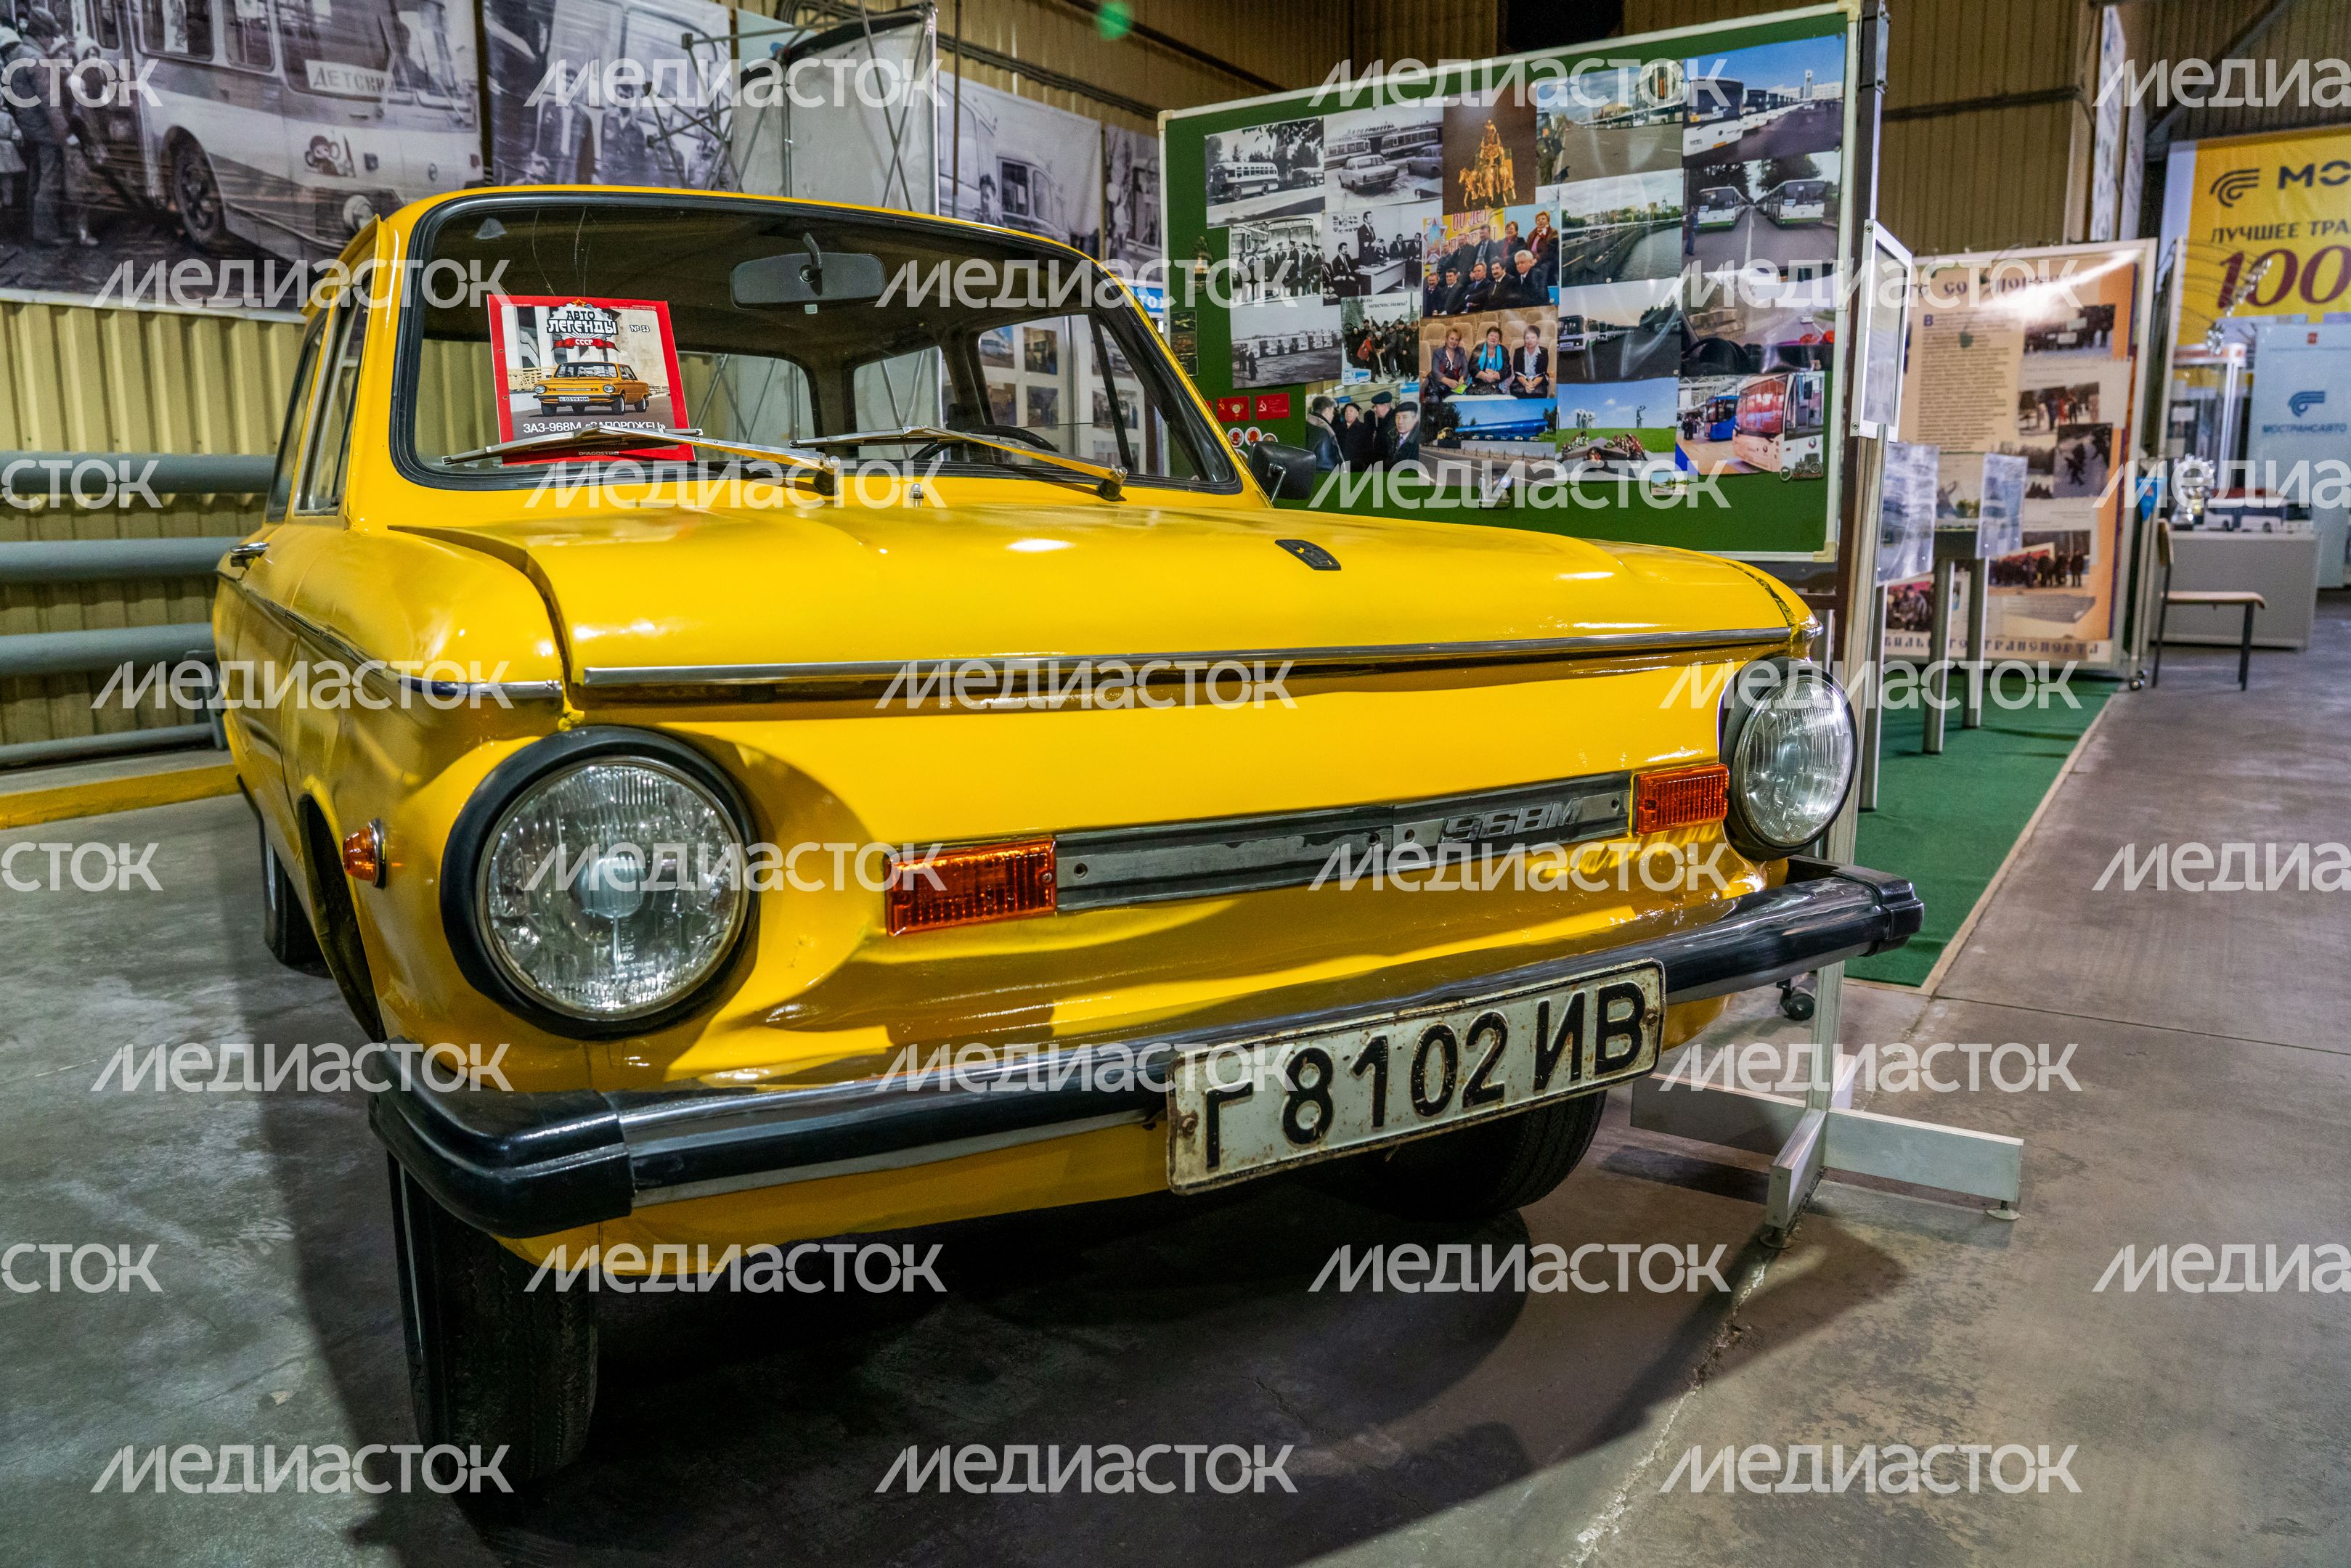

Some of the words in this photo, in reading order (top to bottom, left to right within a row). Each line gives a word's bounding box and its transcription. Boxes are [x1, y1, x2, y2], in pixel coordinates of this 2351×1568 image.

[2211, 221, 2300, 243] ЛУЧШЕЕ
[2217, 245, 2351, 309] 100
[566, 311, 595, 320] АВТО
[547, 319, 617, 333] ЛЕГЕНДЫ
[523, 422, 582, 433] ЗАЗ-968М
[1283, 1012, 1509, 1145] 8102
[1533, 981, 1646, 1090] ИВ
